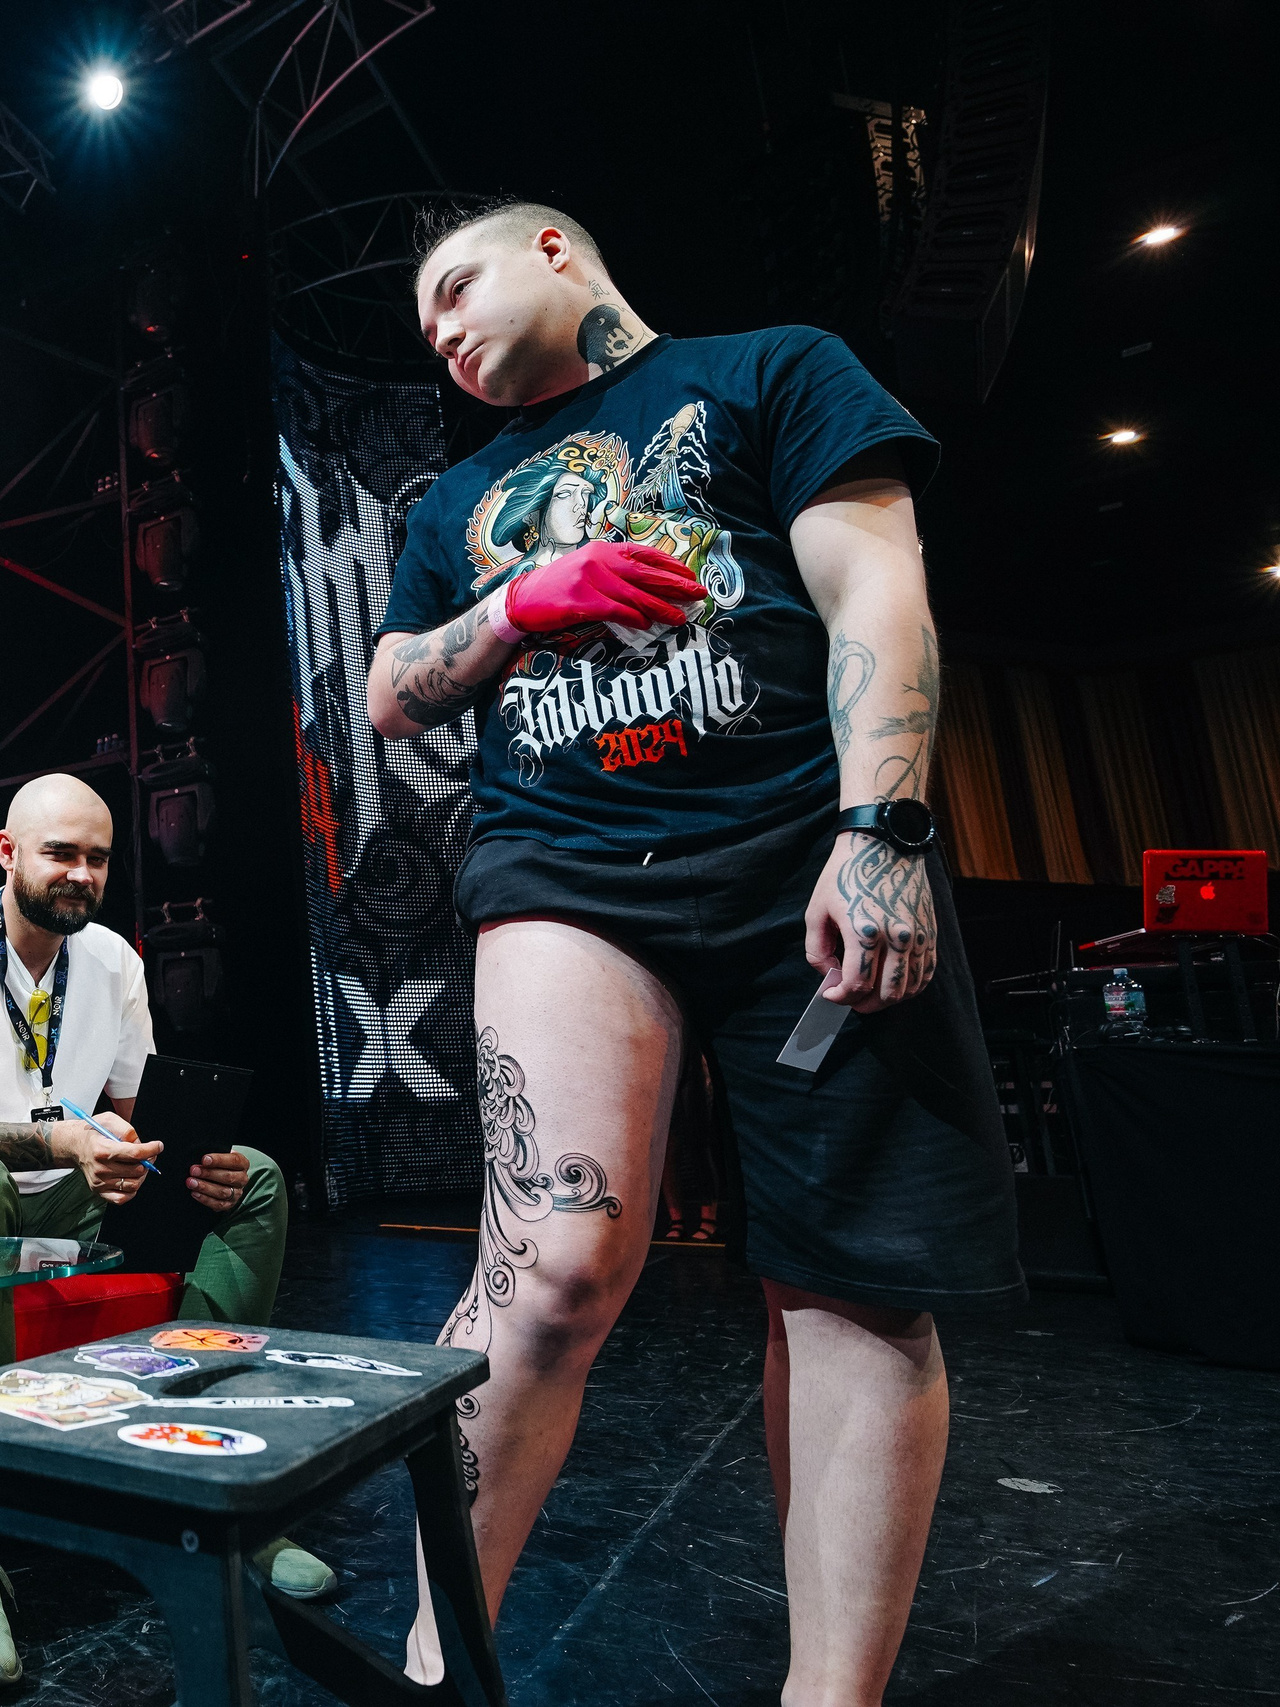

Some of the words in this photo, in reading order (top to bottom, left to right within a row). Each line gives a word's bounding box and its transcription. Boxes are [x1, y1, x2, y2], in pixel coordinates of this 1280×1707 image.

[593, 718, 688, 773] 2024
[52, 995, 63, 1016] NOIR
[15, 1020, 30, 1042] NOIR
